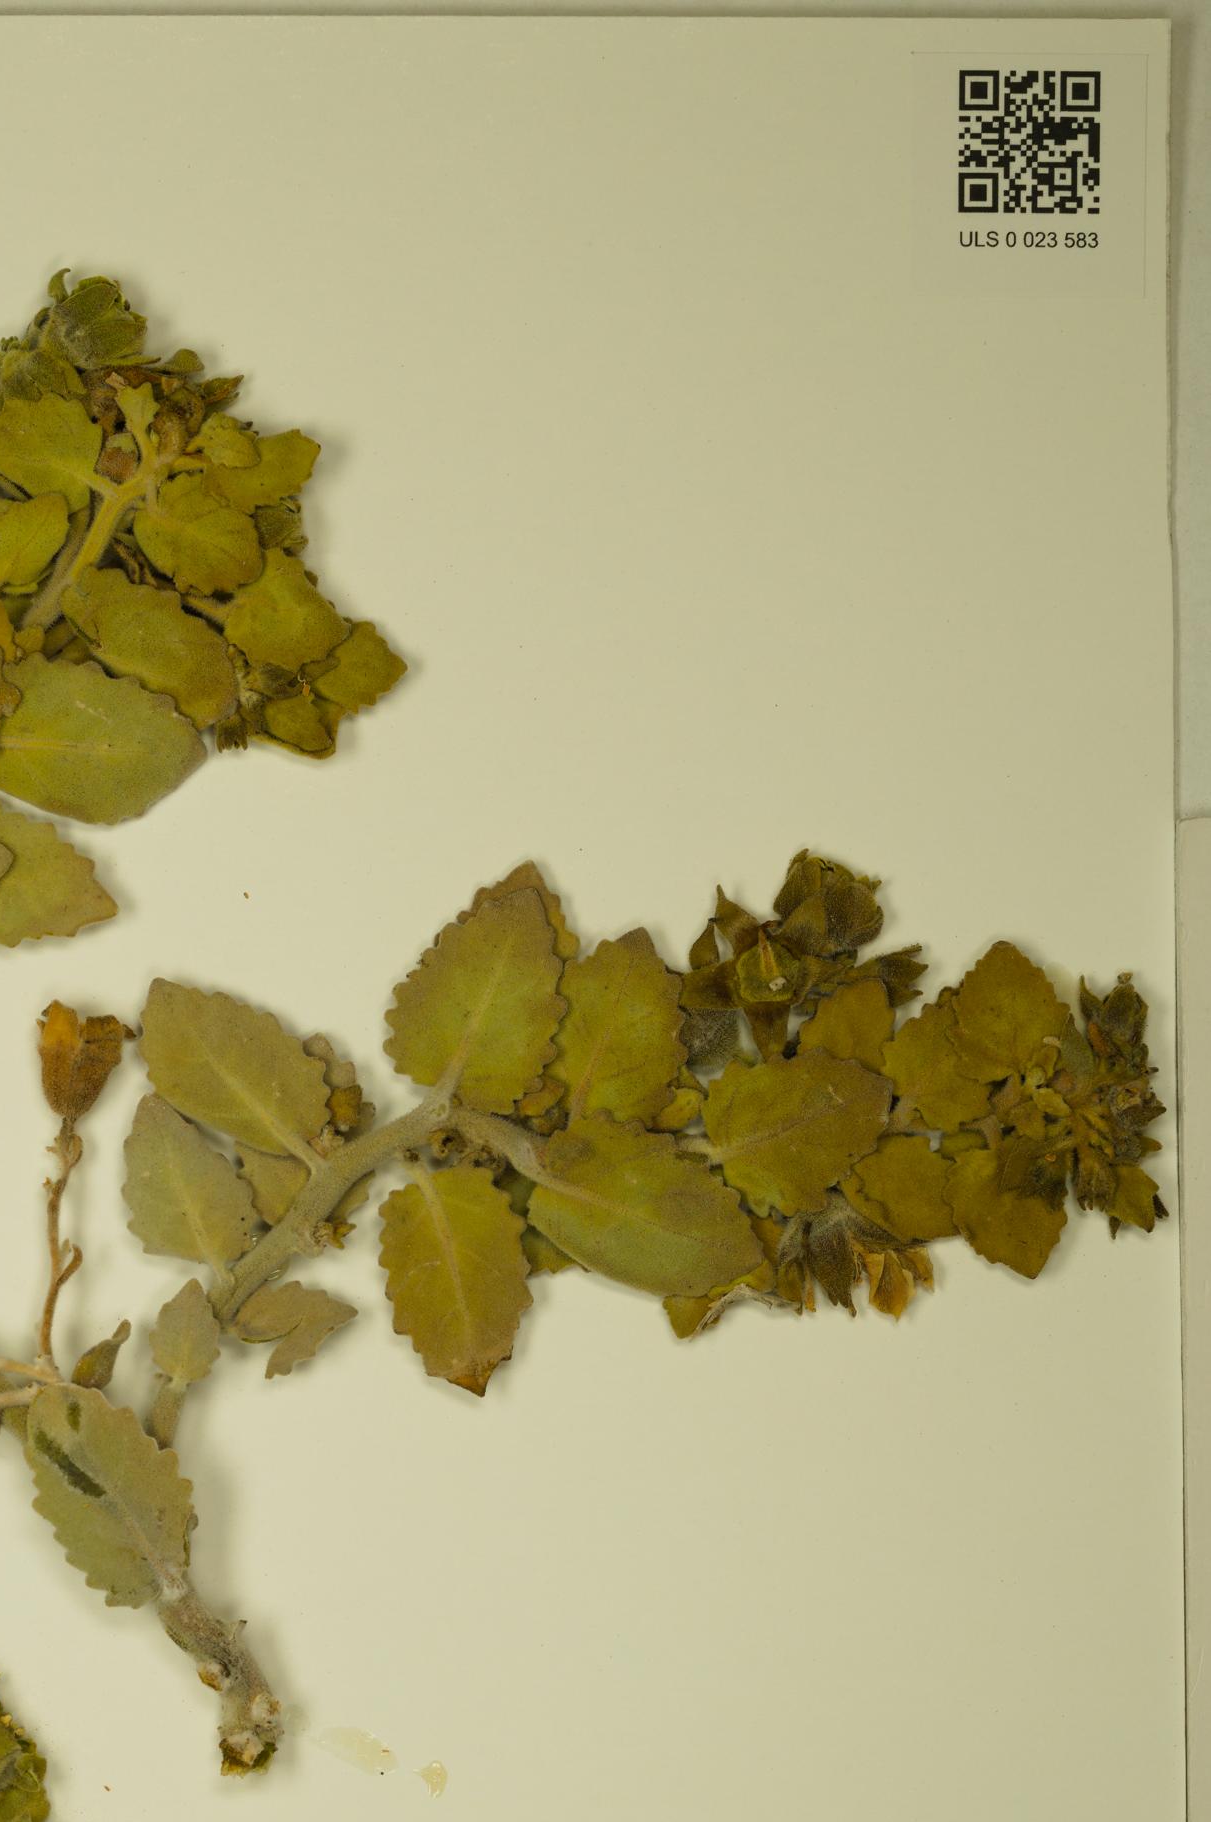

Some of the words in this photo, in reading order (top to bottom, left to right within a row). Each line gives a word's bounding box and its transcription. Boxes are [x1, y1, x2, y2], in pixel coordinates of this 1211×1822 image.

[959, 231, 999, 248] ULS
[1006, 231, 1017, 248] 0
[1023, 231, 1058, 248] 023
[1064, 231, 1099, 249] 583
